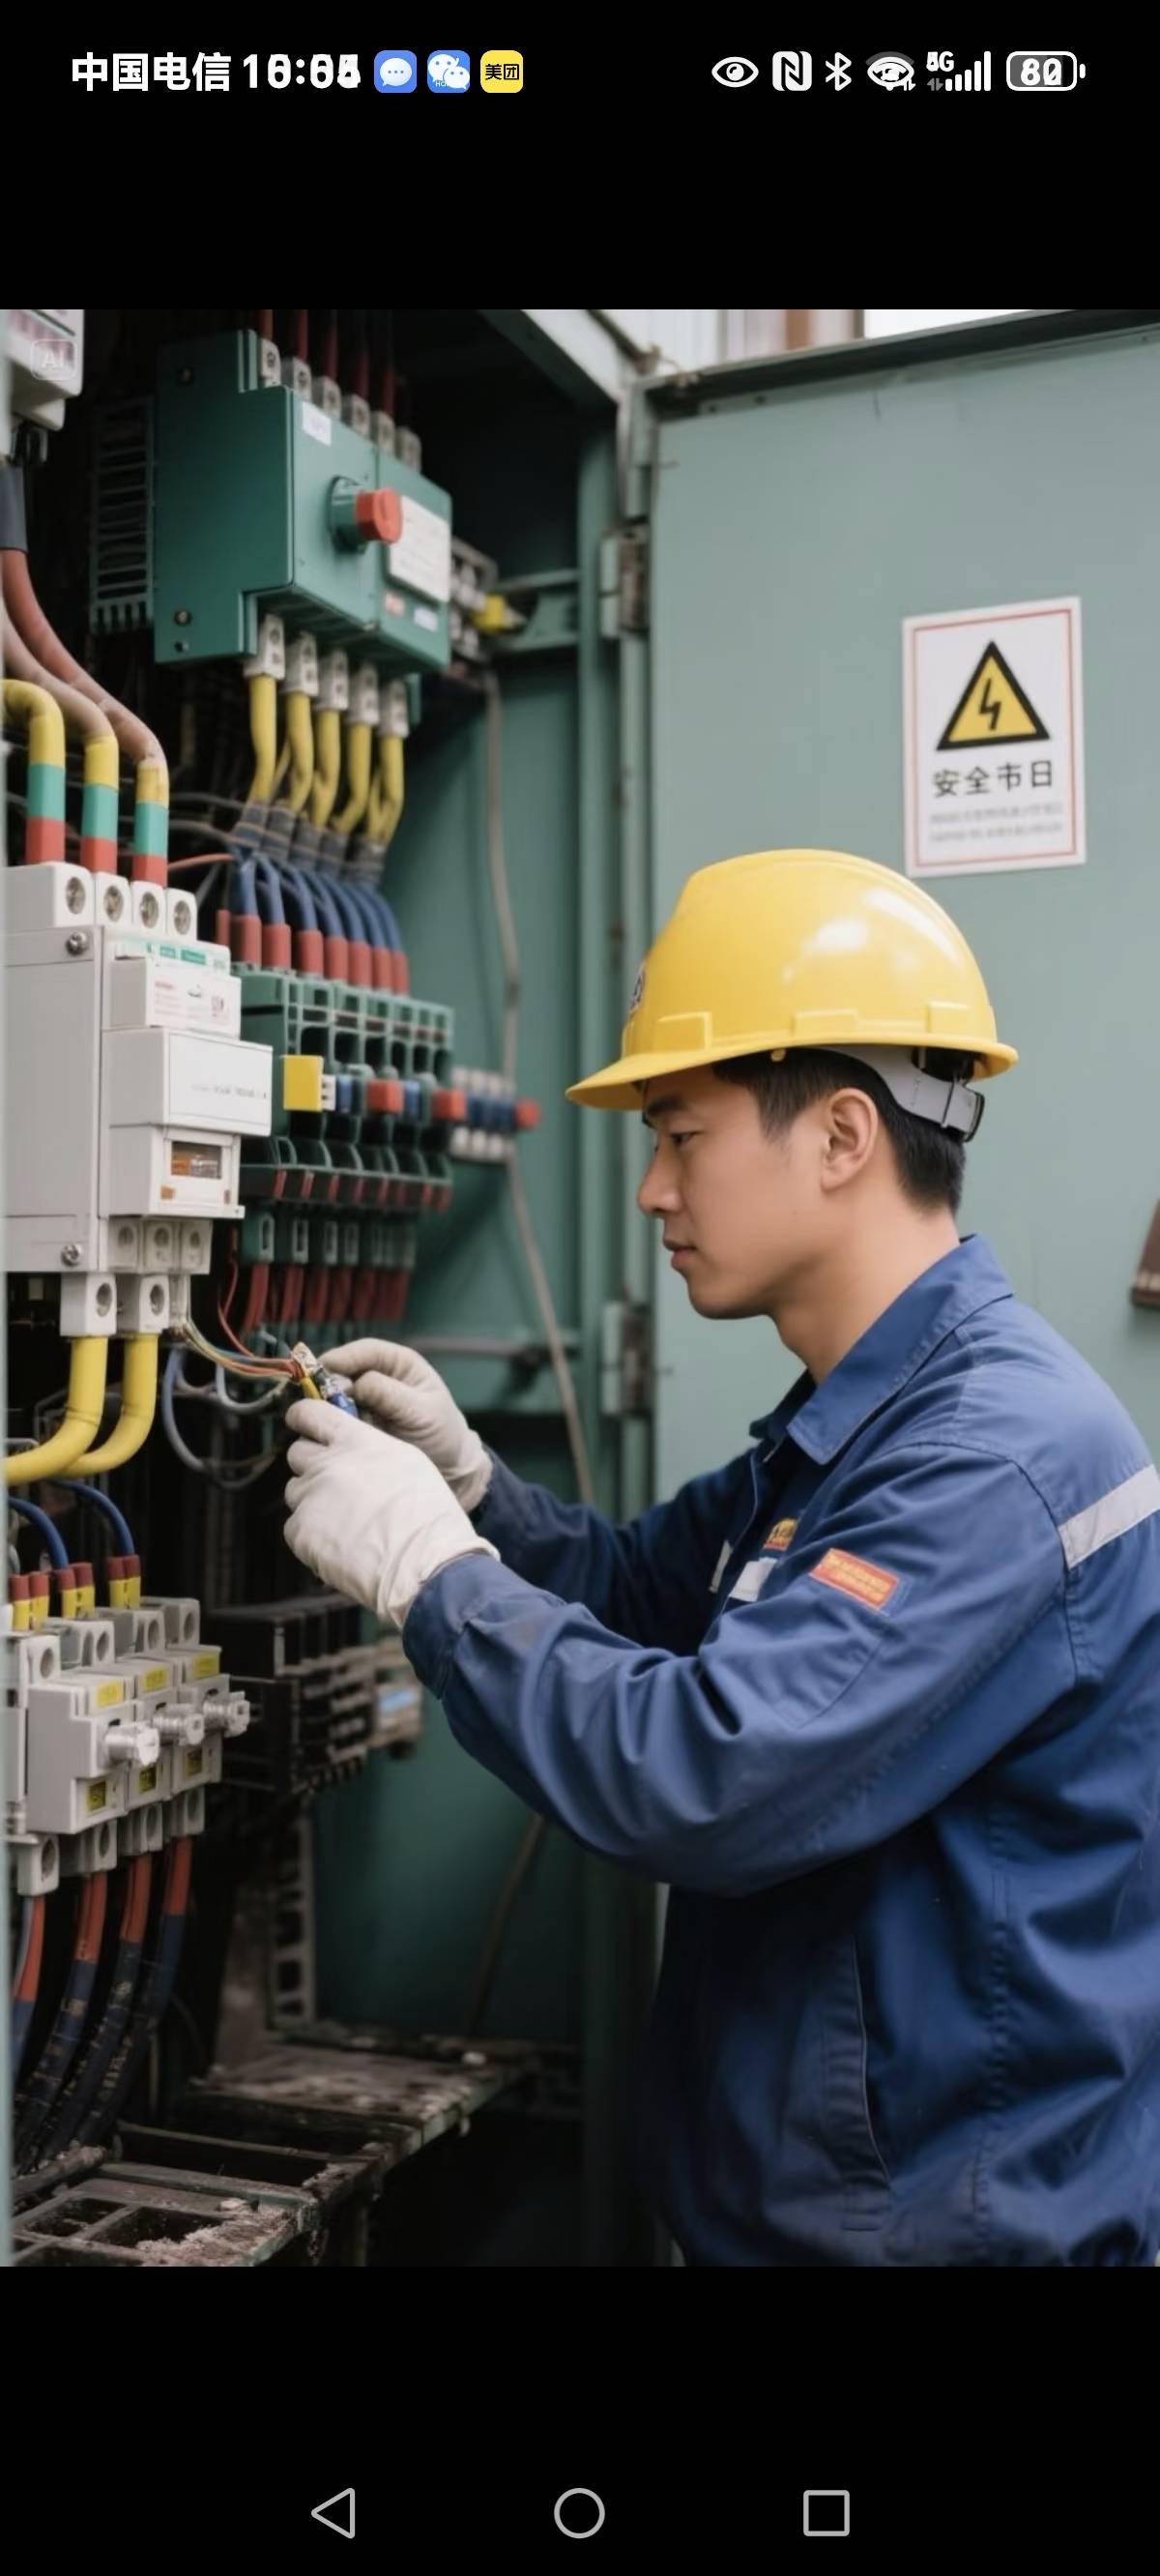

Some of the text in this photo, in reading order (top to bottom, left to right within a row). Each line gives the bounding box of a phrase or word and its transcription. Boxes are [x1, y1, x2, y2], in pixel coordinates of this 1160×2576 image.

[72, 51, 232, 92] 中国电信
[484, 63, 520, 81] 美团
